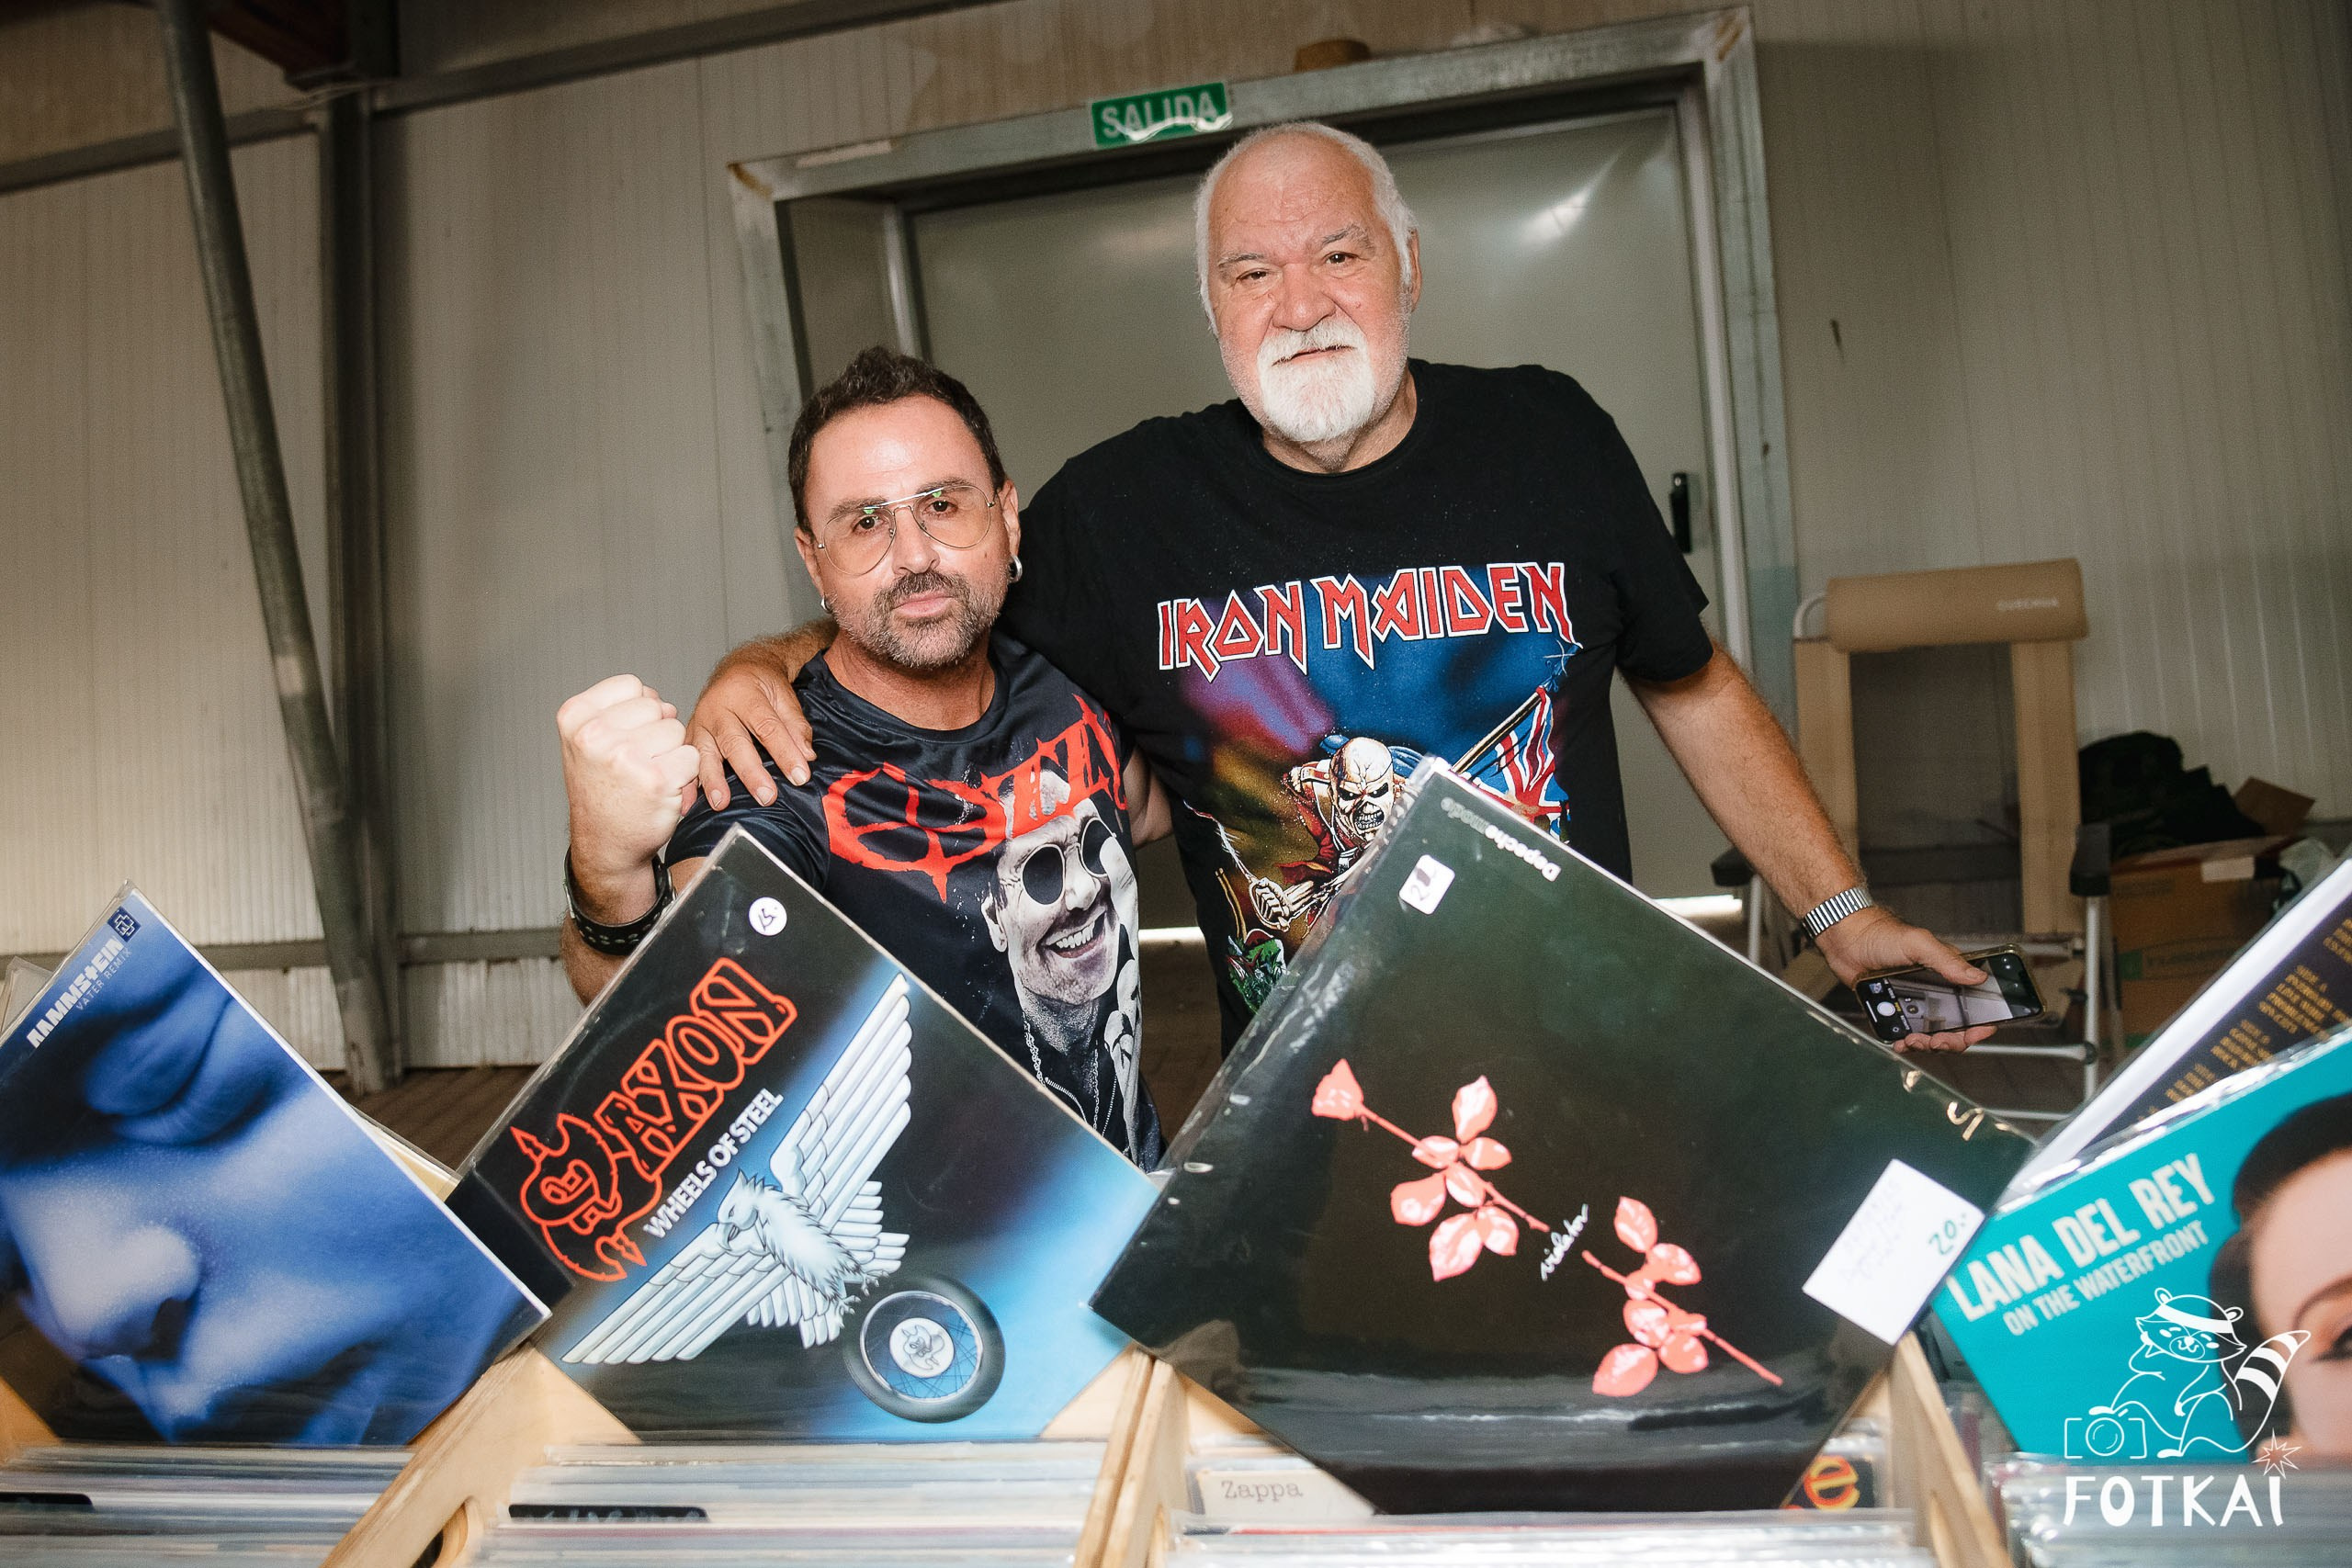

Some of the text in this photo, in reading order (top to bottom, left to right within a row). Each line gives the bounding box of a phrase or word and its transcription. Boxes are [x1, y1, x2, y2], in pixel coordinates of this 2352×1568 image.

[1102, 91, 1217, 138] SALIDA
[1158, 562, 1584, 682] IRON MAIDEN
[76, 947, 132, 1010] VATER REMIX
[510, 957, 797, 1281] SAXON
[643, 1088, 784, 1238] WHEELS OF STEEL
[1945, 1153, 2215, 1322] LANA DEL REY
[2003, 1220, 2210, 1337] ON THE WATERFRONT
[1220, 1480, 1304, 1502] Zappa
